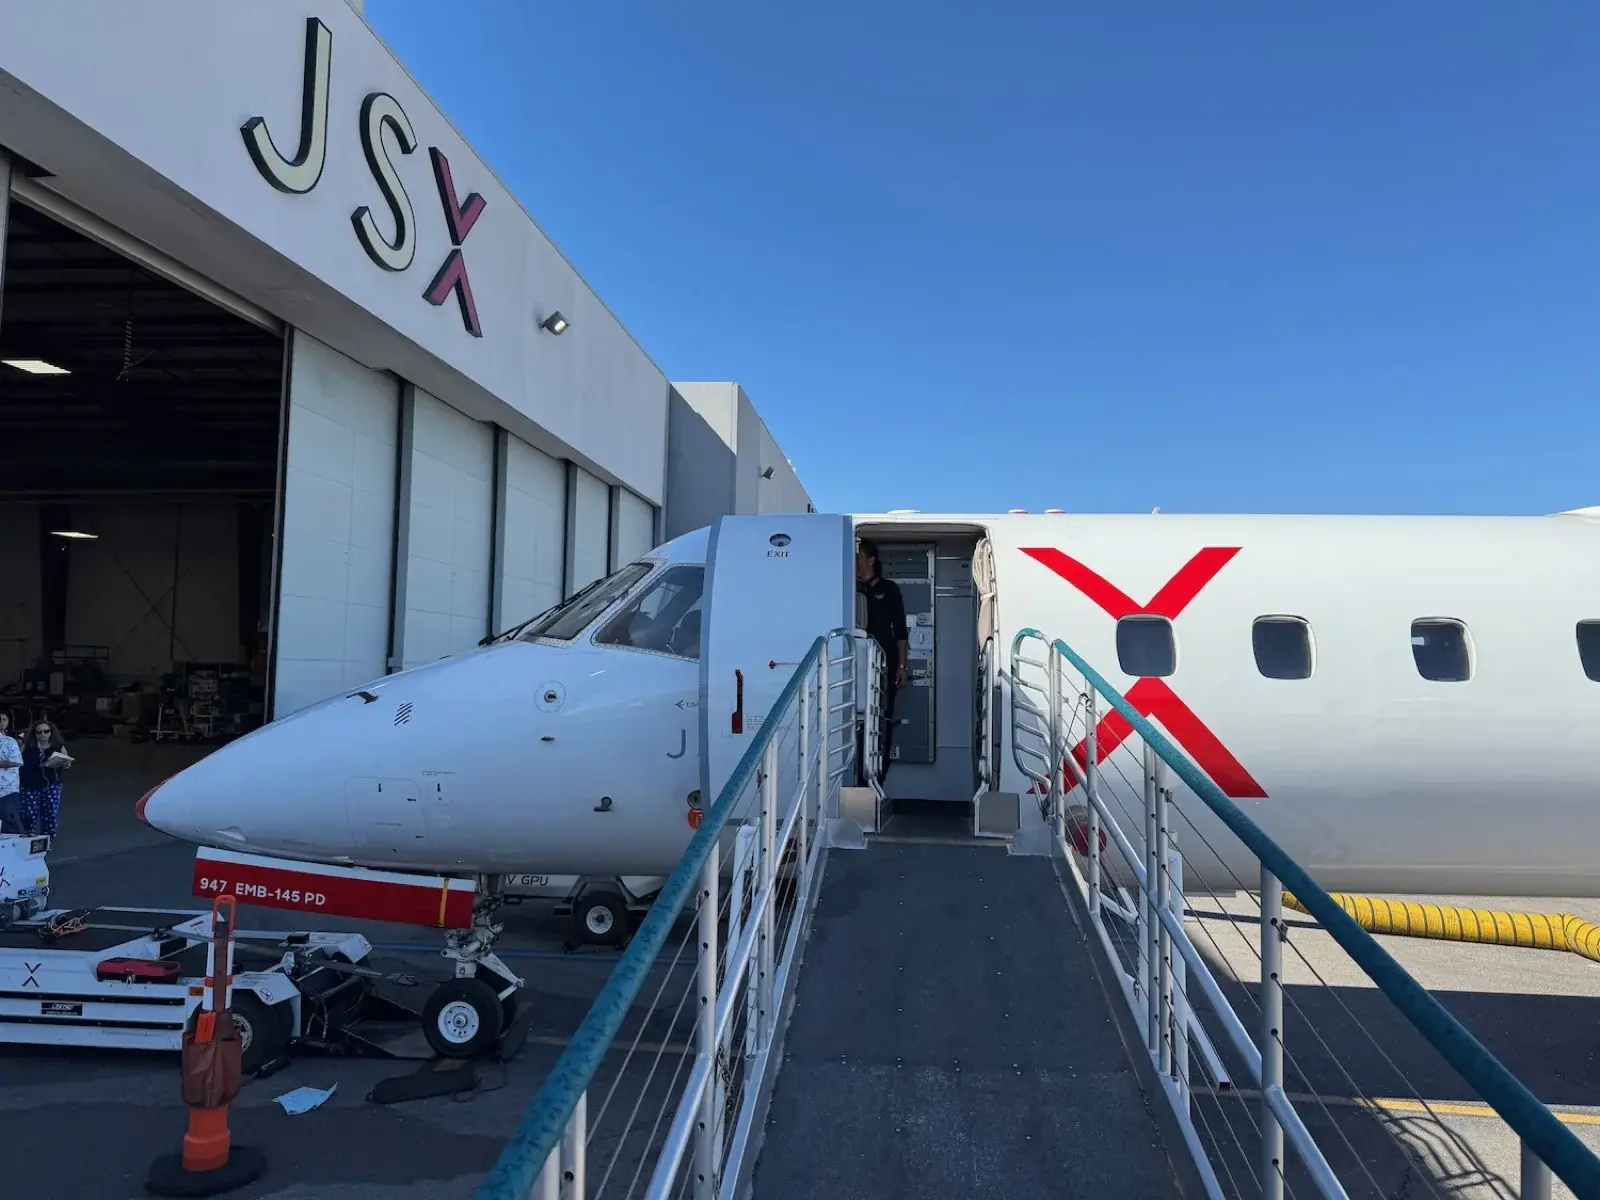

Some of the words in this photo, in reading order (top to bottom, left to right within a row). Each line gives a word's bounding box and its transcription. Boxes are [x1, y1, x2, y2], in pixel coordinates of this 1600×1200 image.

[240, 17, 486, 338] JSX
[767, 550, 790, 558] EXIT
[521, 875, 548, 886] GPU
[200, 877, 227, 892] 947
[235, 882, 300, 903] EMB-145
[304, 892, 326, 906] PD
